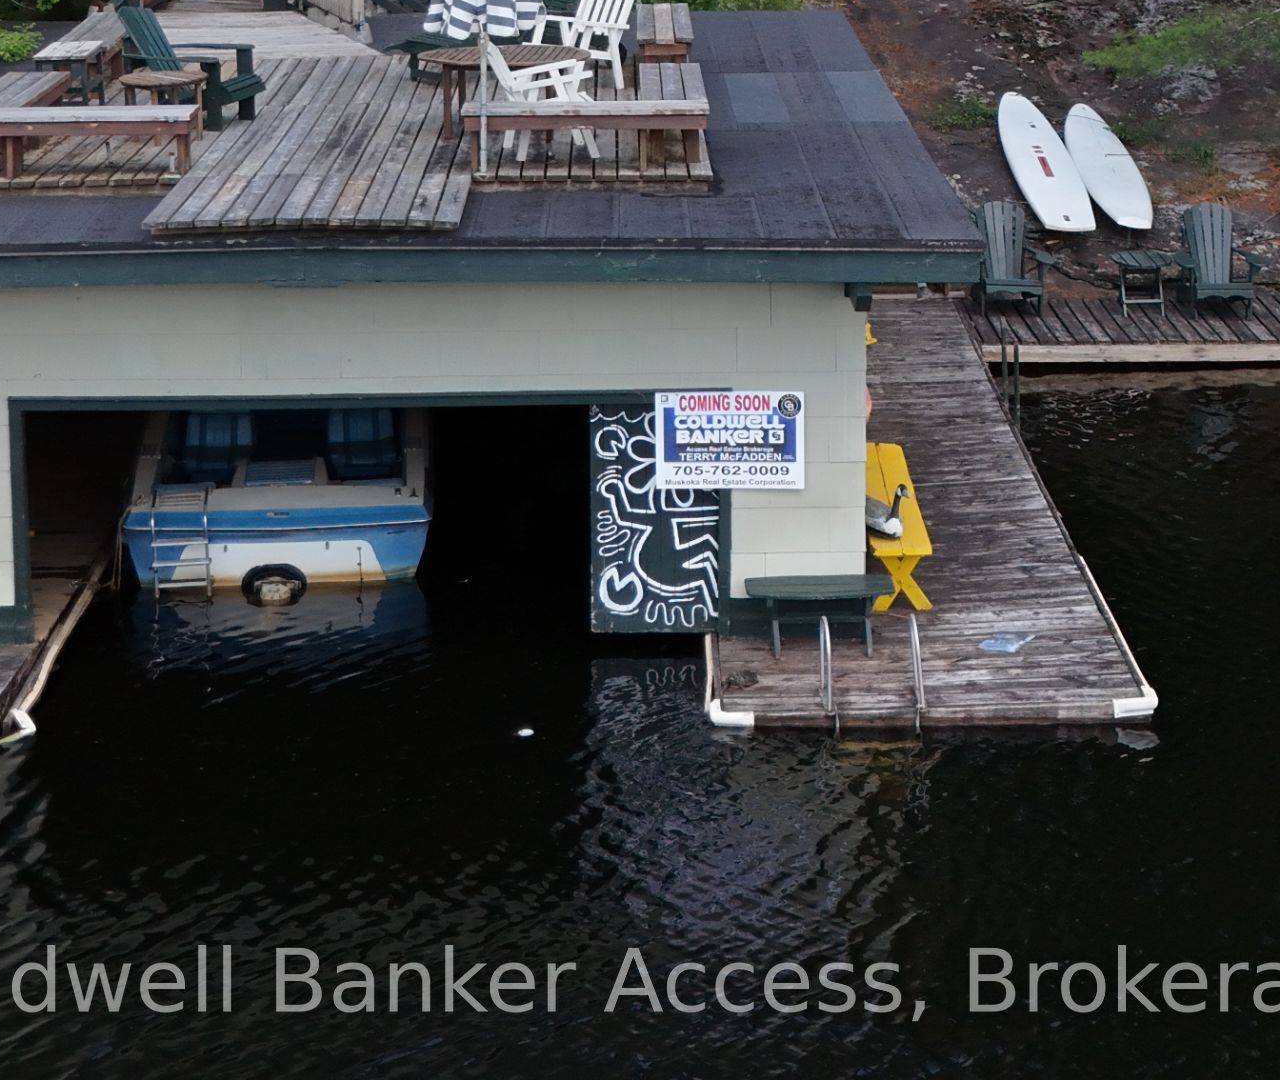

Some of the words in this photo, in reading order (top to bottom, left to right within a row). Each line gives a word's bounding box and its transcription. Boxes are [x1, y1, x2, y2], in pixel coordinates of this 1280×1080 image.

[679, 395, 730, 412] COMING
[734, 395, 771, 411] SOON
[674, 415, 786, 430] COLDWELL
[676, 430, 764, 446] BANKER
[679, 453, 717, 461] TERRY
[721, 453, 782, 461] McFADDEN
[673, 465, 790, 476] 705-762-0009
[722, 479, 746, 487] Estate
